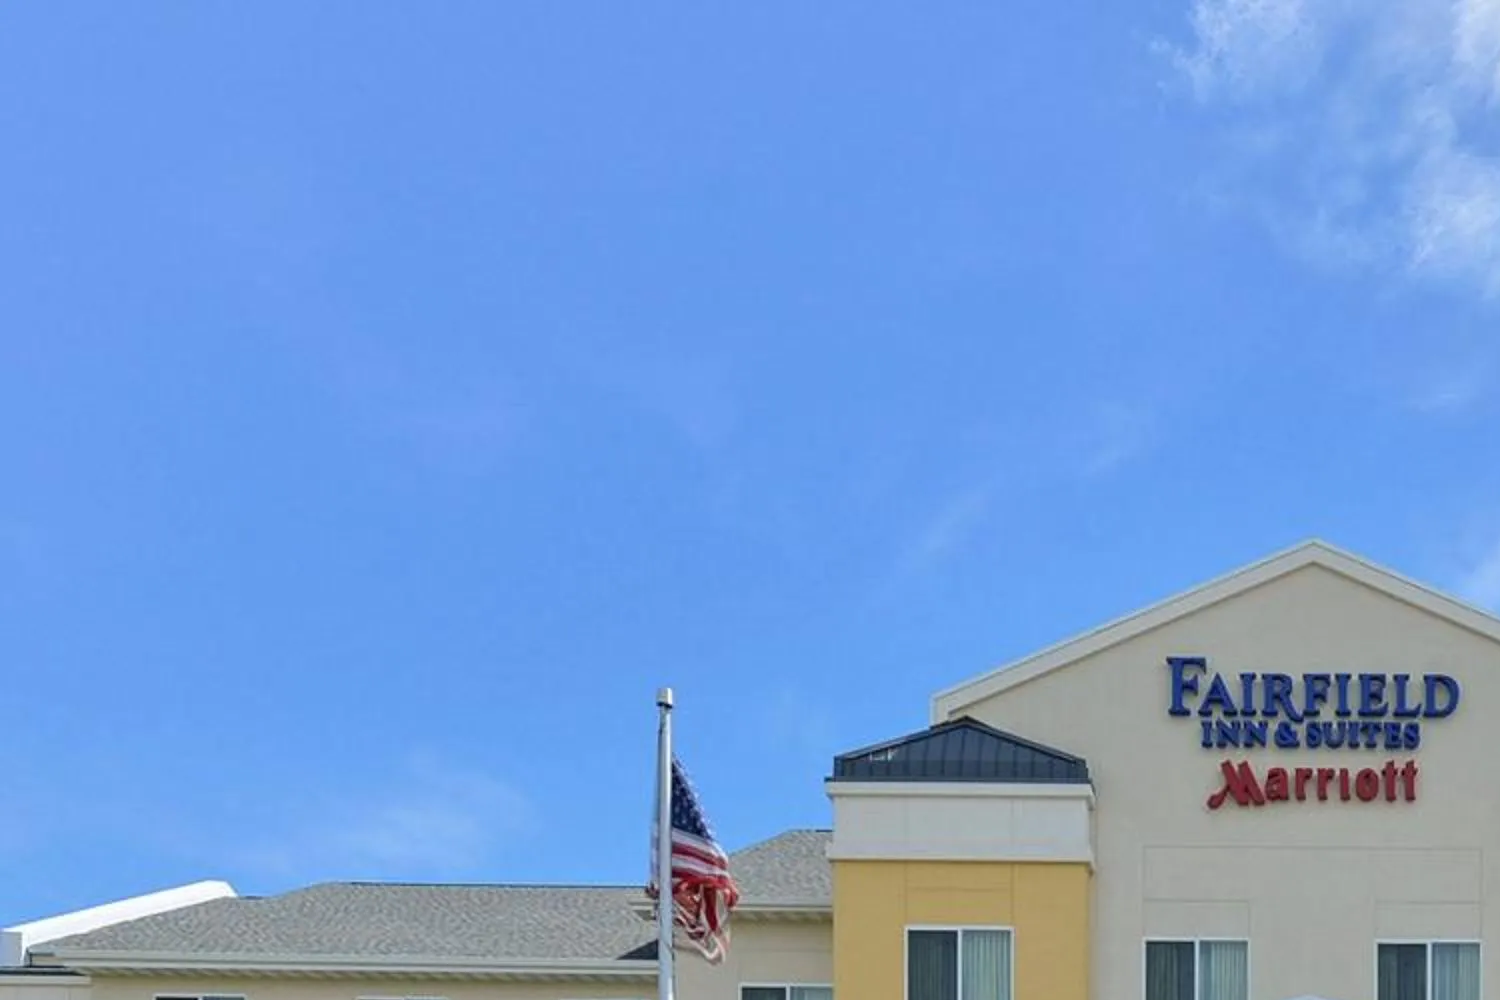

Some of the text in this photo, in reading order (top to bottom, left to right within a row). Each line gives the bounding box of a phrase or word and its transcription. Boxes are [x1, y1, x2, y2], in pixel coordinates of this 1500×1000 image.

[1166, 656, 1460, 723] FAIRFIELD
[1201, 720, 1421, 750] INN & SUITES
[1206, 760, 1418, 810] Marriott
